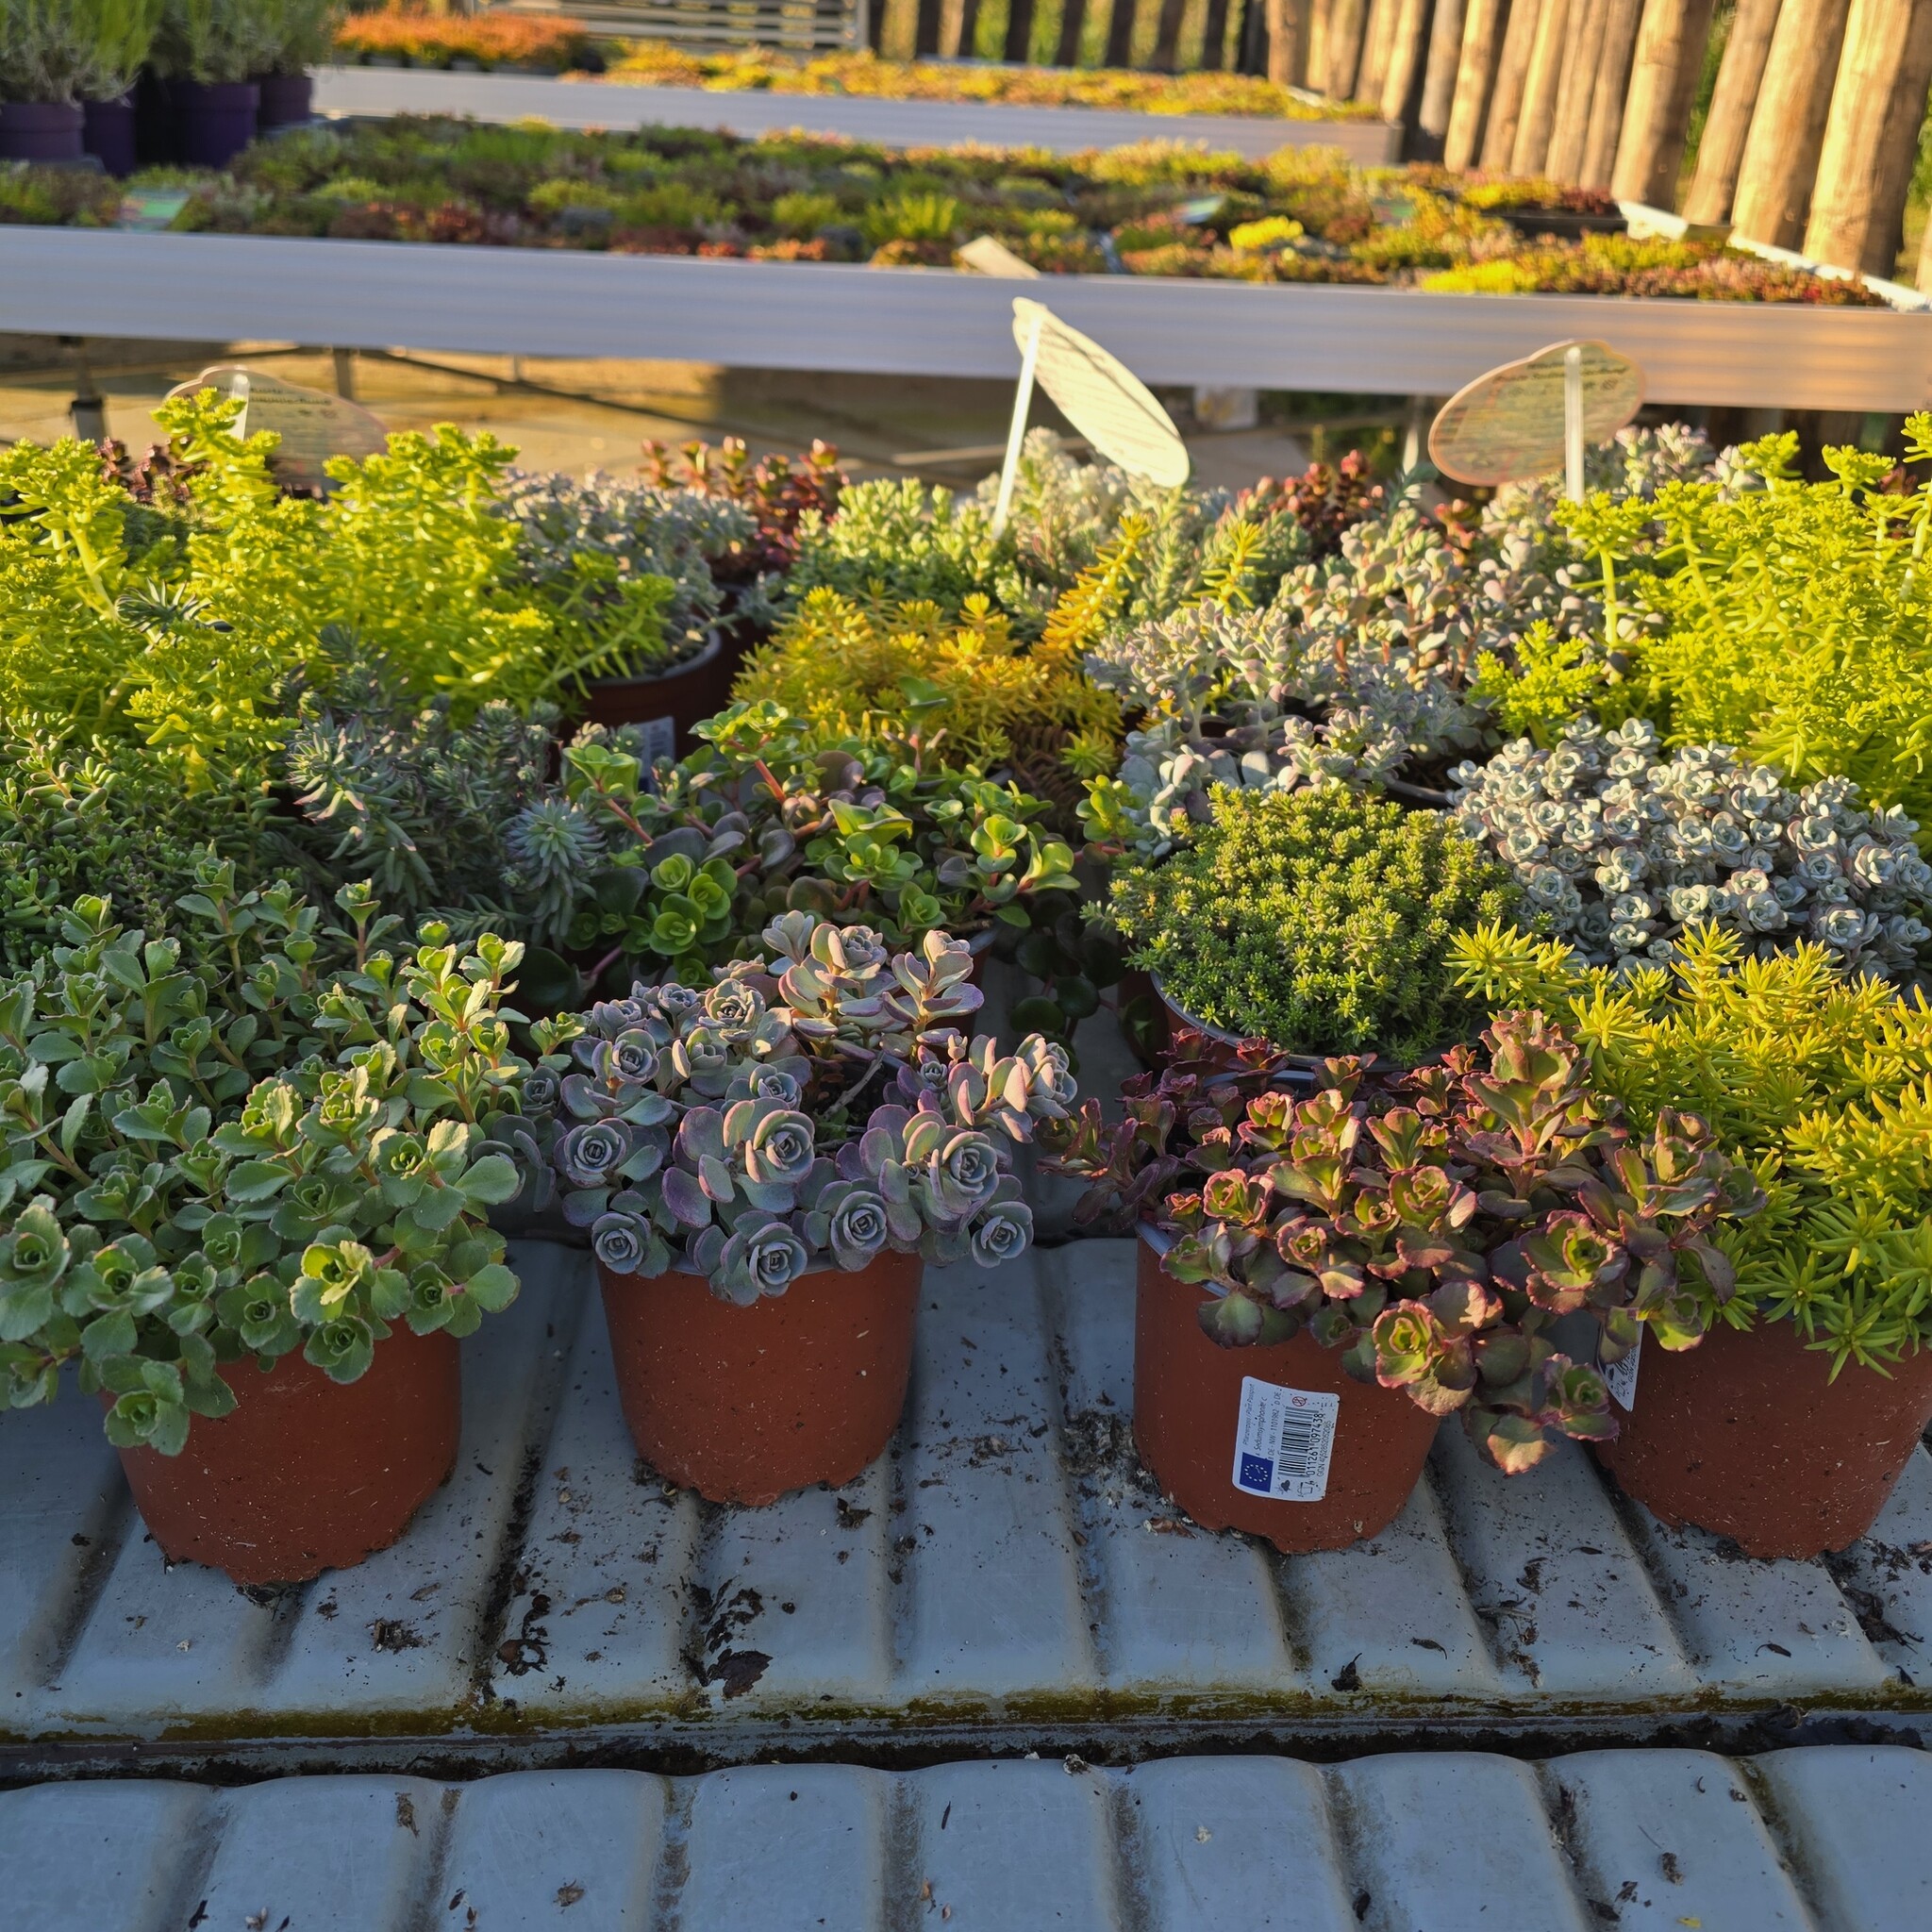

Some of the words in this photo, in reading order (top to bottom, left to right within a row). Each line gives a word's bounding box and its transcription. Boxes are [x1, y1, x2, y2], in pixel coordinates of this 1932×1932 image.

[1309, 1413, 1324, 1443] 097438
[1268, 1448, 1274, 1457] DE
[1306, 1447, 1319, 1475] 011261
